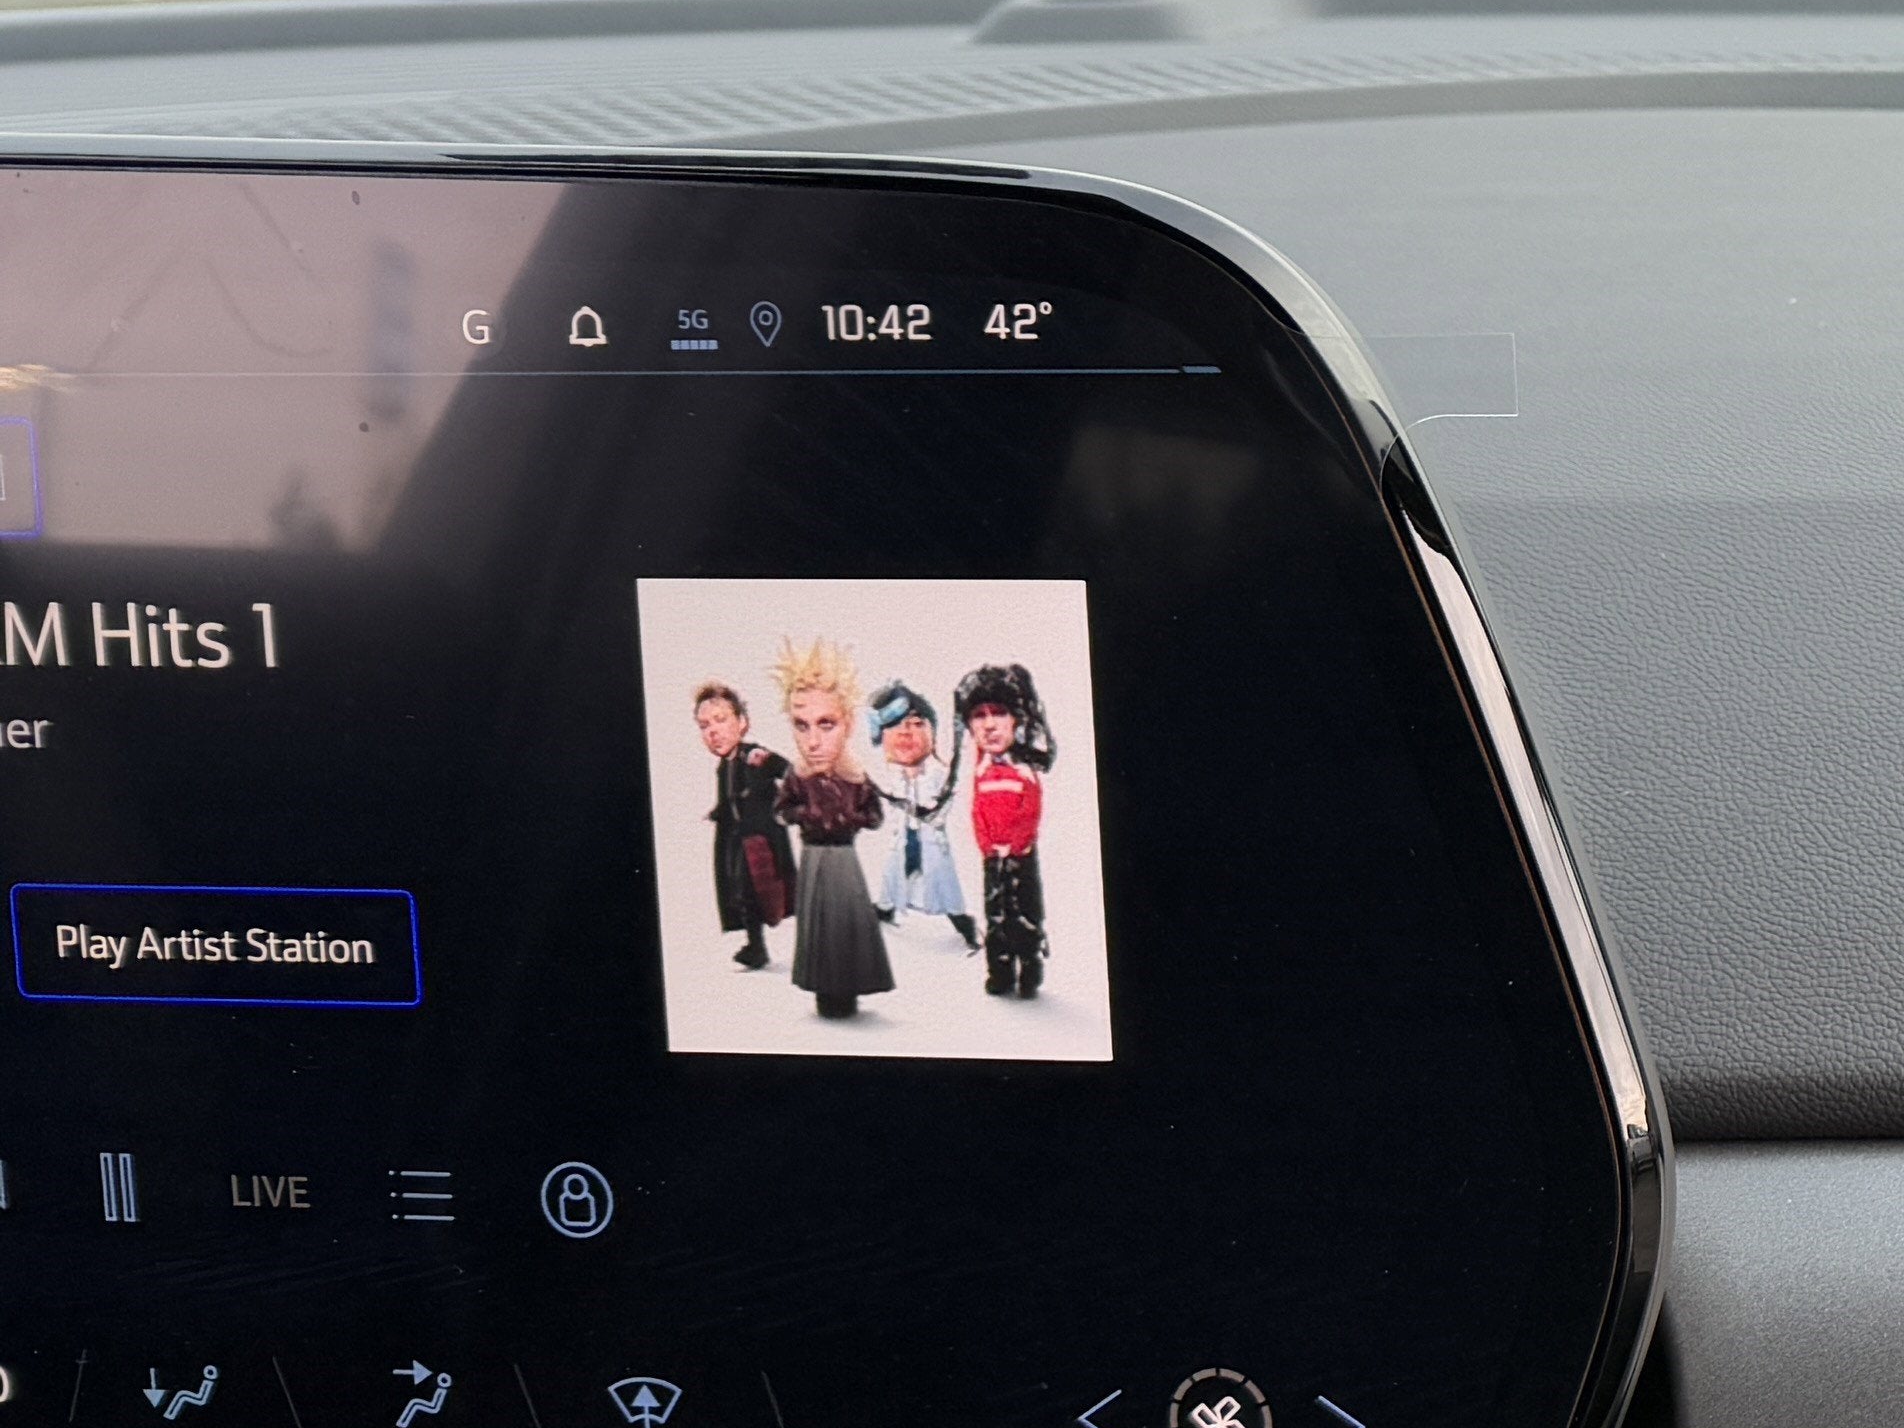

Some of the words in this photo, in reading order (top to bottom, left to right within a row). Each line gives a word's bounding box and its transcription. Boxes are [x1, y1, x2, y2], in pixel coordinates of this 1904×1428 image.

[461, 308, 492, 346] G
[677, 309, 710, 332] 5G
[821, 303, 933, 342] 10:42
[983, 301, 1055, 341] 42°
[0, 601, 68, 667] M
[91, 601, 232, 669] Hits
[251, 602, 280, 669] 1
[56, 924, 127, 969] Play
[137, 926, 239, 962] Artist
[246, 928, 375, 964] Station
[231, 1174, 311, 1209] LIVE
